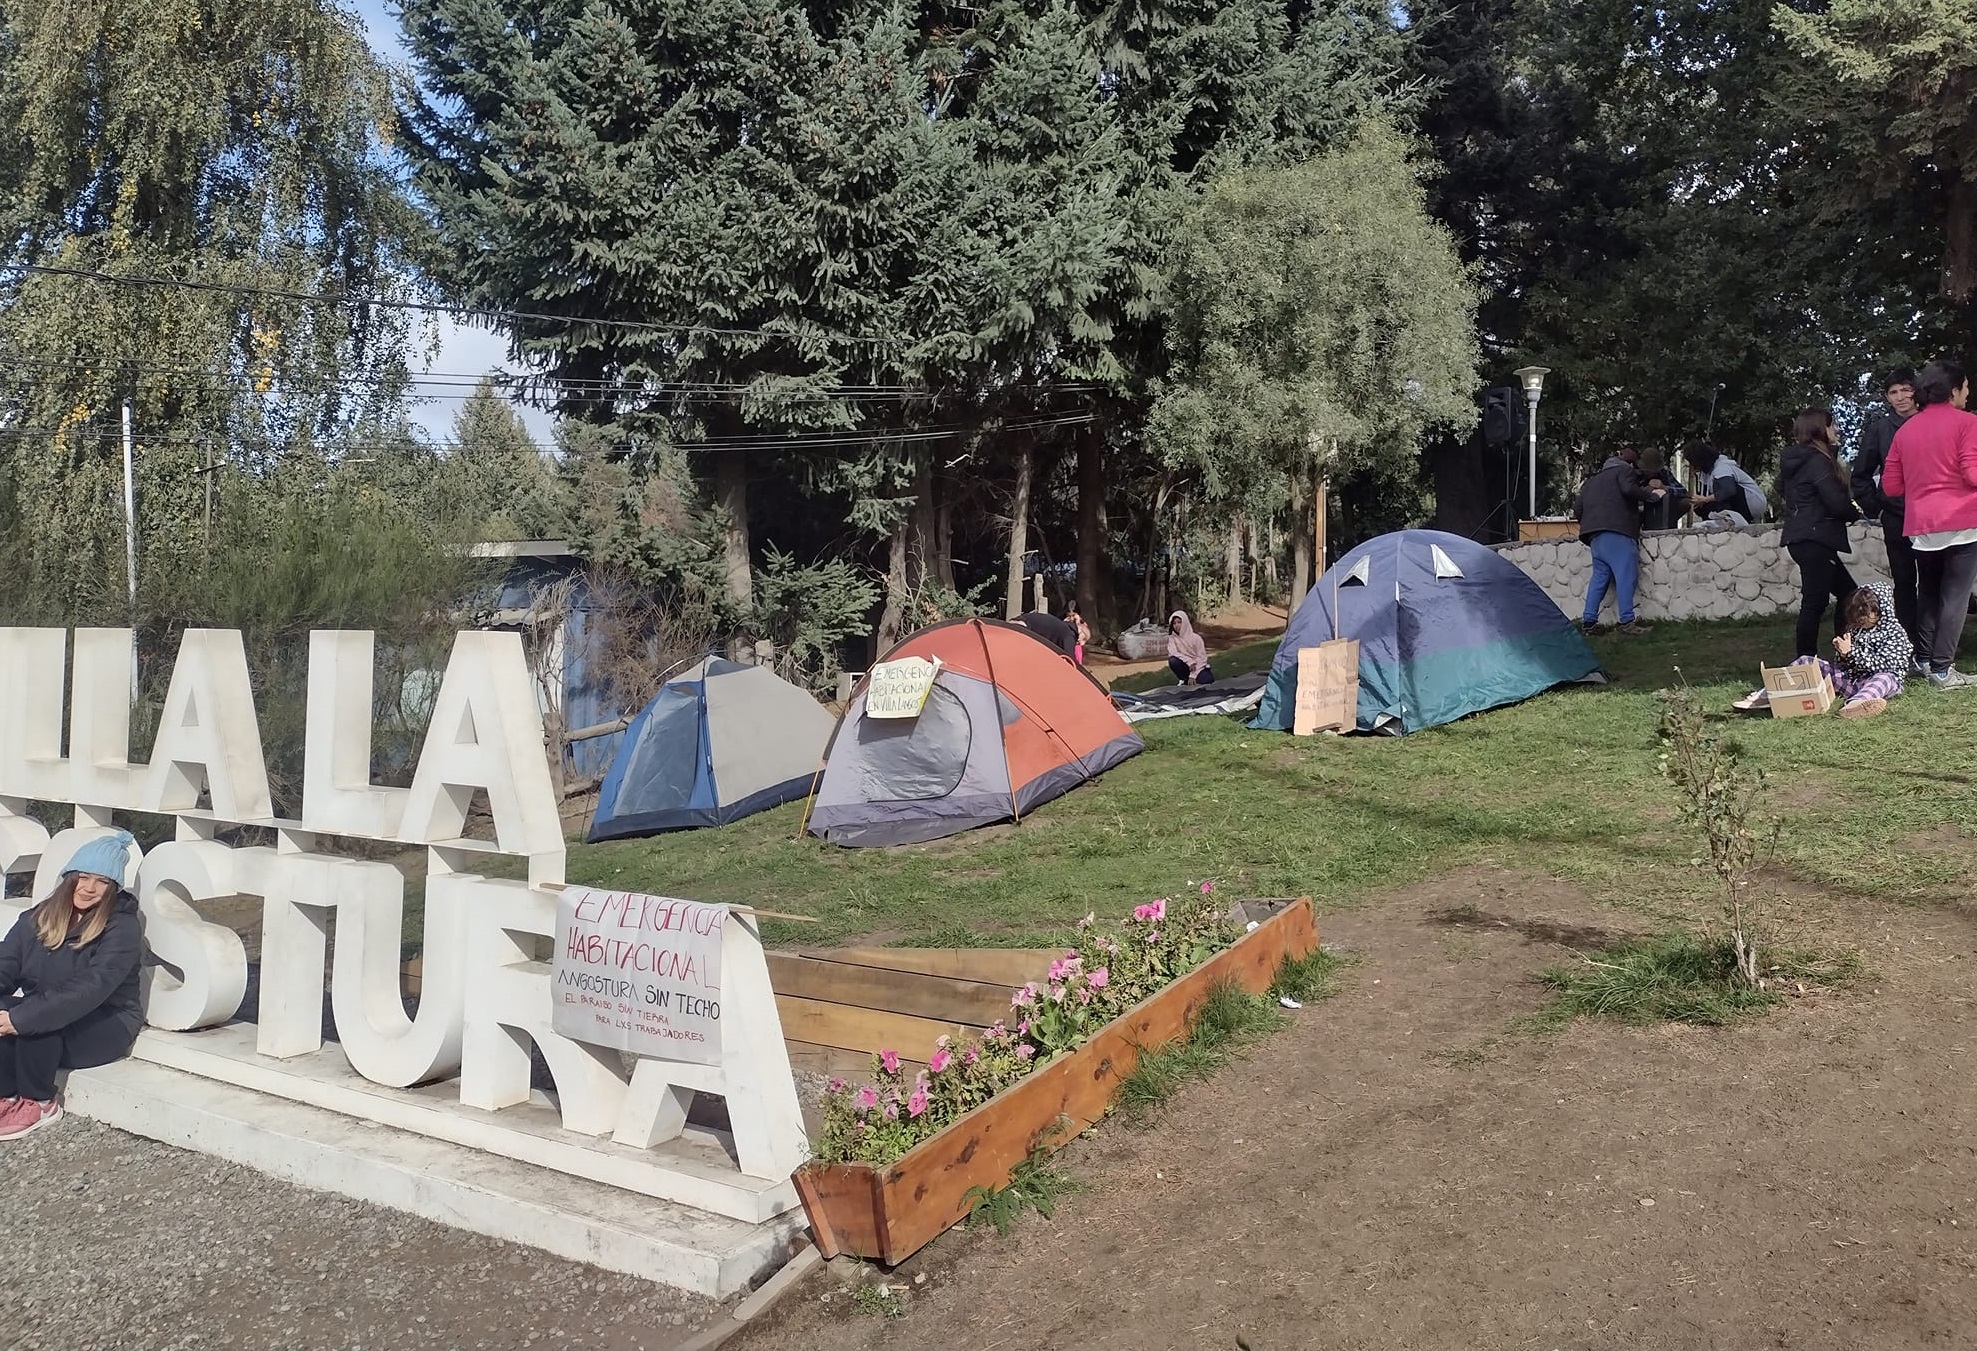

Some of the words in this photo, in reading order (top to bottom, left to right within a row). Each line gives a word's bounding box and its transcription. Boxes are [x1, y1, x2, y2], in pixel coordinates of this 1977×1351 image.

[302, 629, 566, 857] LA
[566, 927, 721, 990] HABITACIONAL
[558, 969, 639, 1002] ANGOSTURA
[645, 985, 670, 1008] SIN
[675, 993, 721, 1020] TECHO
[565, 993, 577, 1004] EL
[580, 995, 613, 1010] PARAISO
[618, 1003, 634, 1015] SIN
[637, 1009, 670, 1026] TIERRA
[615, 1020, 632, 1031] LXS
[634, 1023, 705, 1042] TRABAJADORES
